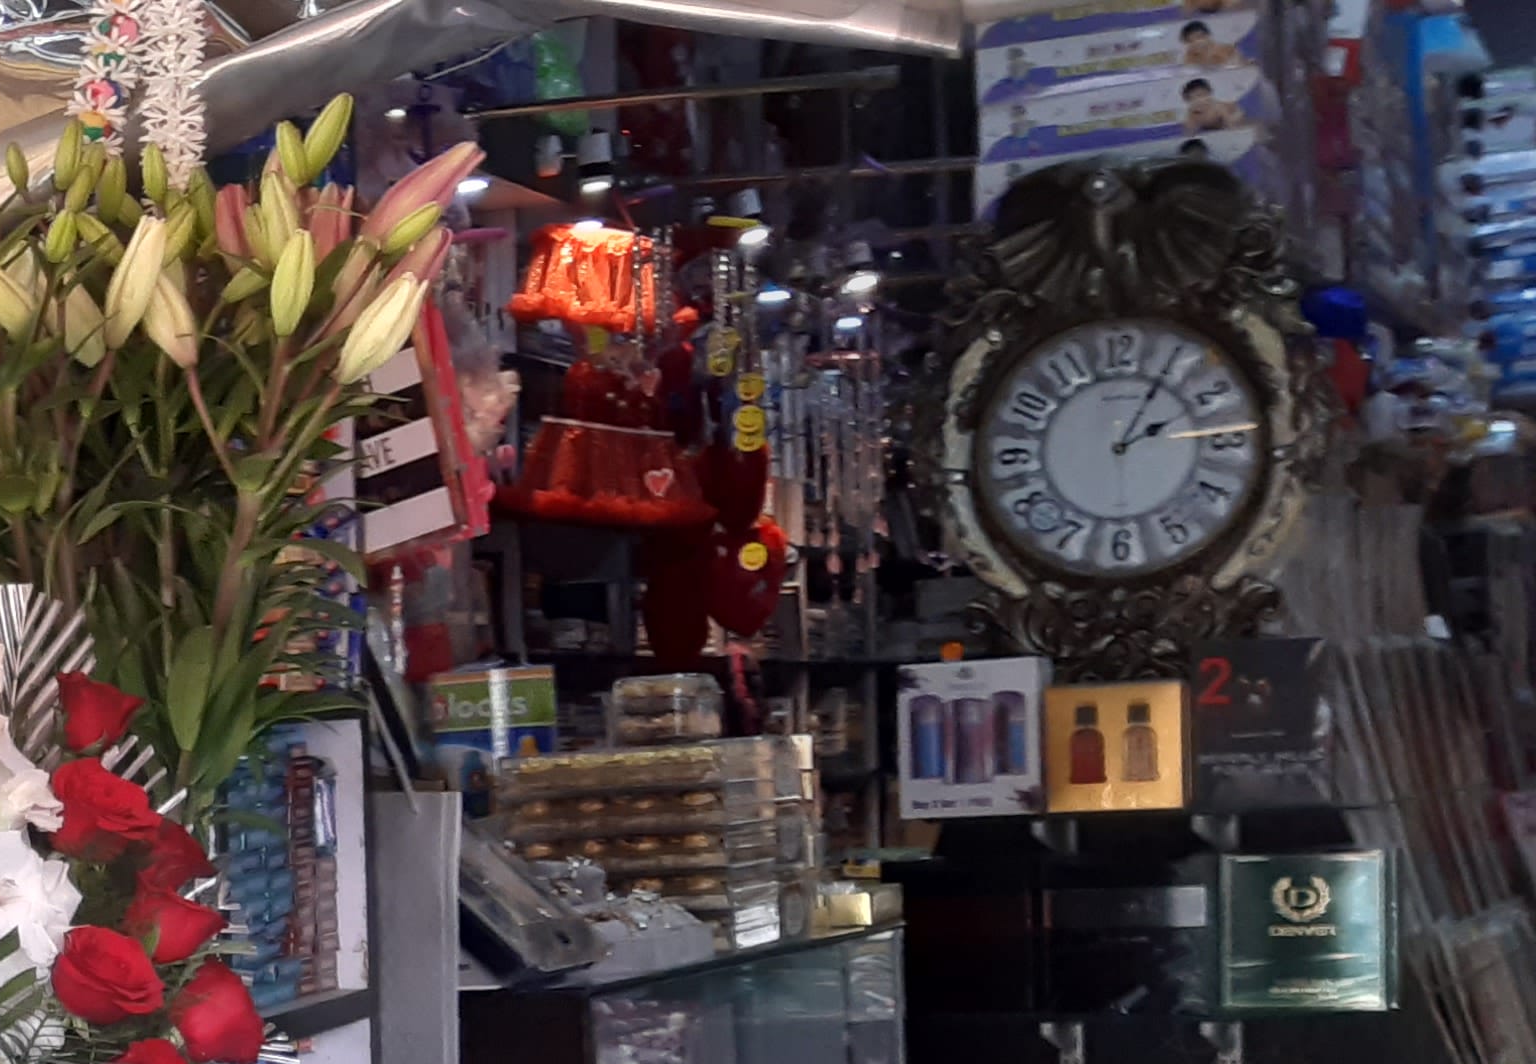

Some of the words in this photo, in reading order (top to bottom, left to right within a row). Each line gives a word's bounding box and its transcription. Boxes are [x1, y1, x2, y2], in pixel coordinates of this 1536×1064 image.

[1105, 334, 1135, 369] 12
[1047, 351, 1088, 388] 11
[1011, 391, 1049, 422] 10
[1194, 380, 1228, 406] 2
[997, 446, 1031, 466] 9
[1056, 517, 1084, 550] 7
[1110, 528, 1132, 561] 6
[1158, 514, 1190, 545] 5
[1198, 656, 1233, 706] 2
